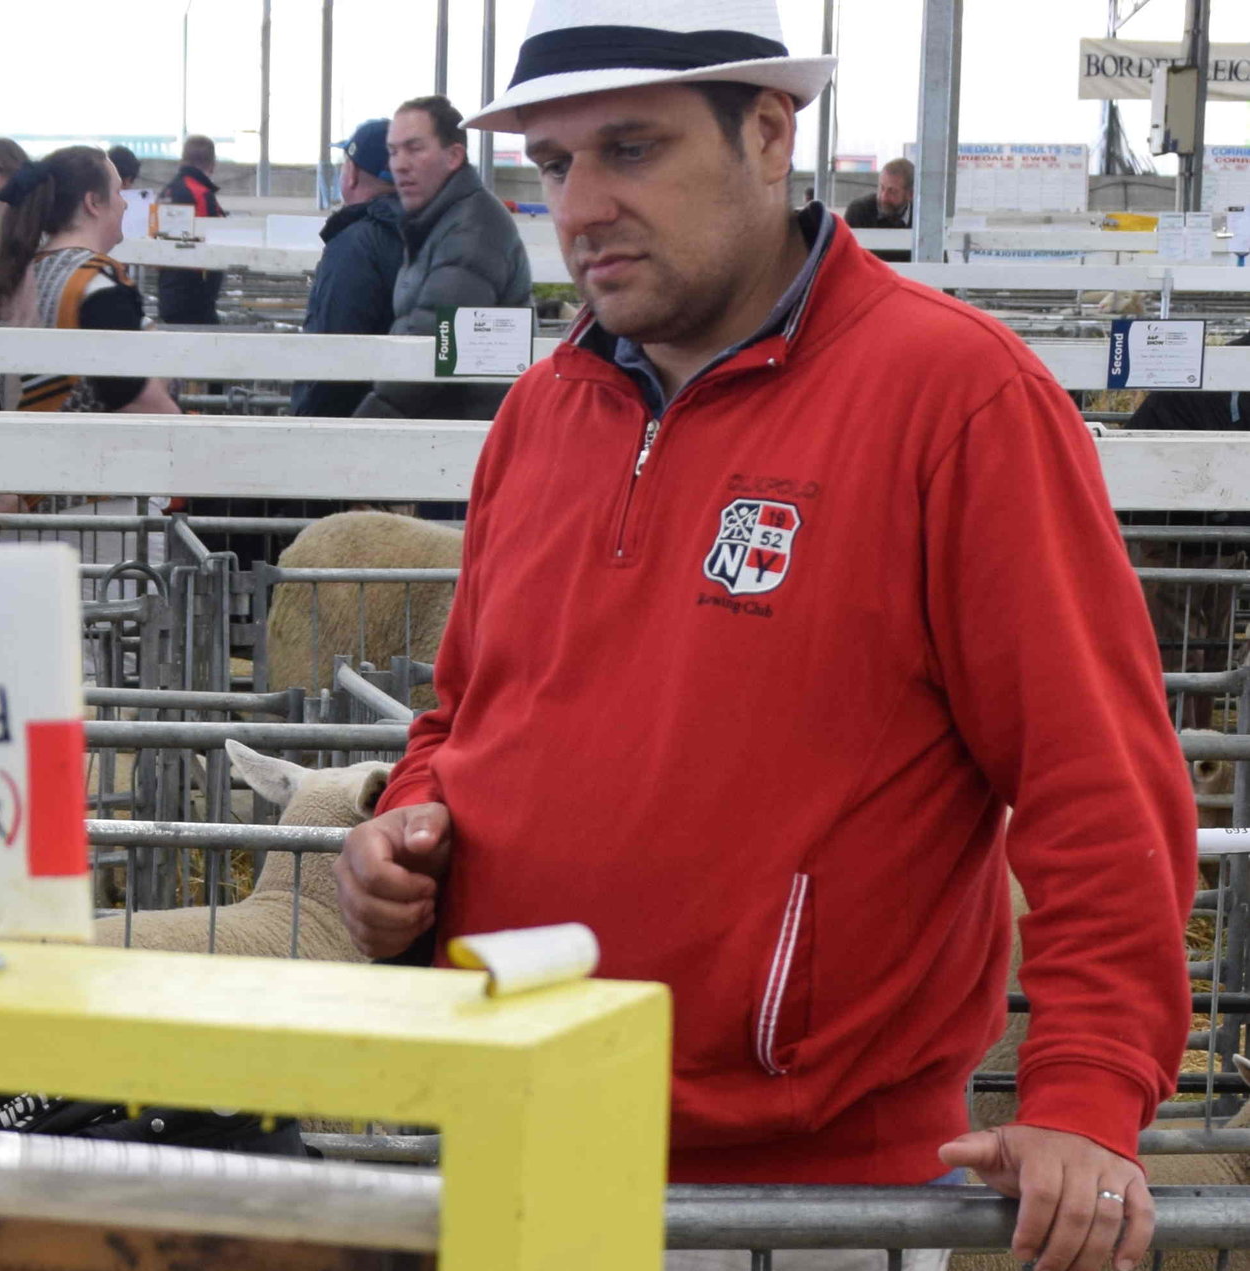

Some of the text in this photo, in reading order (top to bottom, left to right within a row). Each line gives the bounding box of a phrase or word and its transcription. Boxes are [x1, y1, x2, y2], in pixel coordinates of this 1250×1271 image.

[1084, 54, 1250, 82] BORD EIC
[438, 320, 450, 361] Fourth
[1111, 333, 1124, 375] Second
[768, 510, 786, 528] 19
[760, 531, 783, 549] 52
[712, 544, 778, 583] N Y
